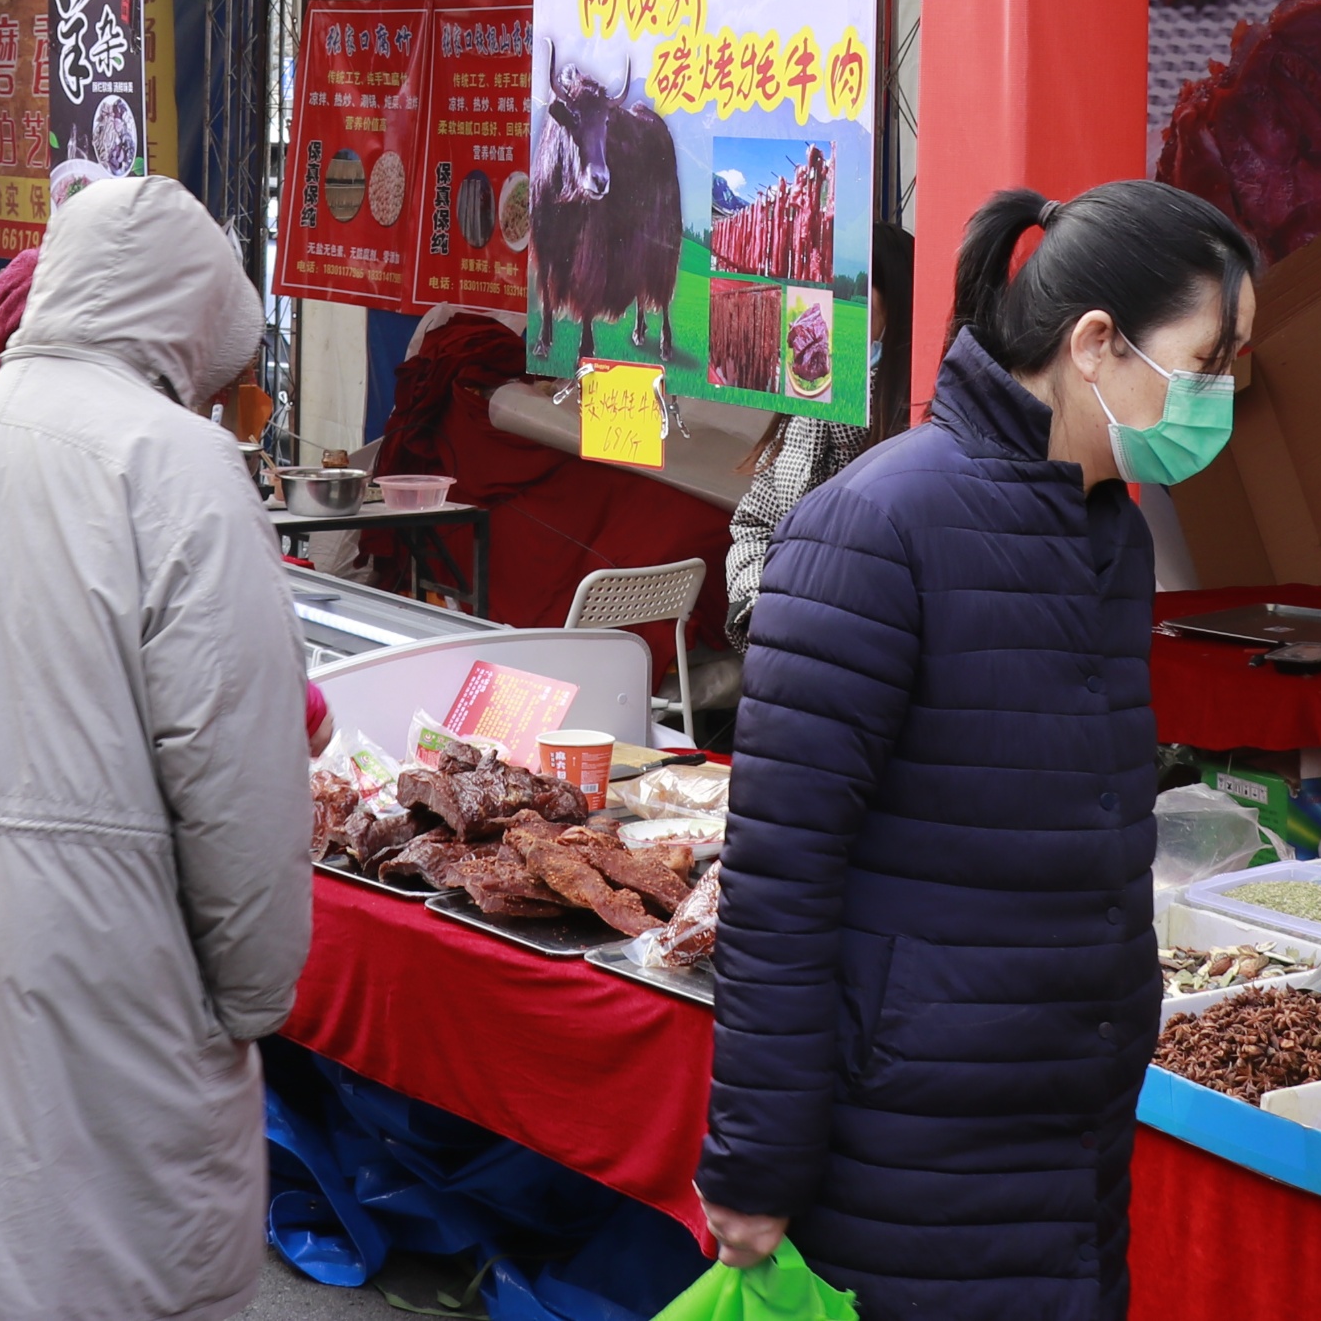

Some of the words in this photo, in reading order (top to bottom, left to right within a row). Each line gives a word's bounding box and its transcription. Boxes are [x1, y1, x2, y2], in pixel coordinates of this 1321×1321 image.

[326, 22, 413, 58] 张家口腐竹
[472, 144, 514, 162] 营养价值高
[29, 183, 50, 220] 保
[300, 140, 323, 229] 保真保纯
[430, 161, 452, 256] 保真保纯
